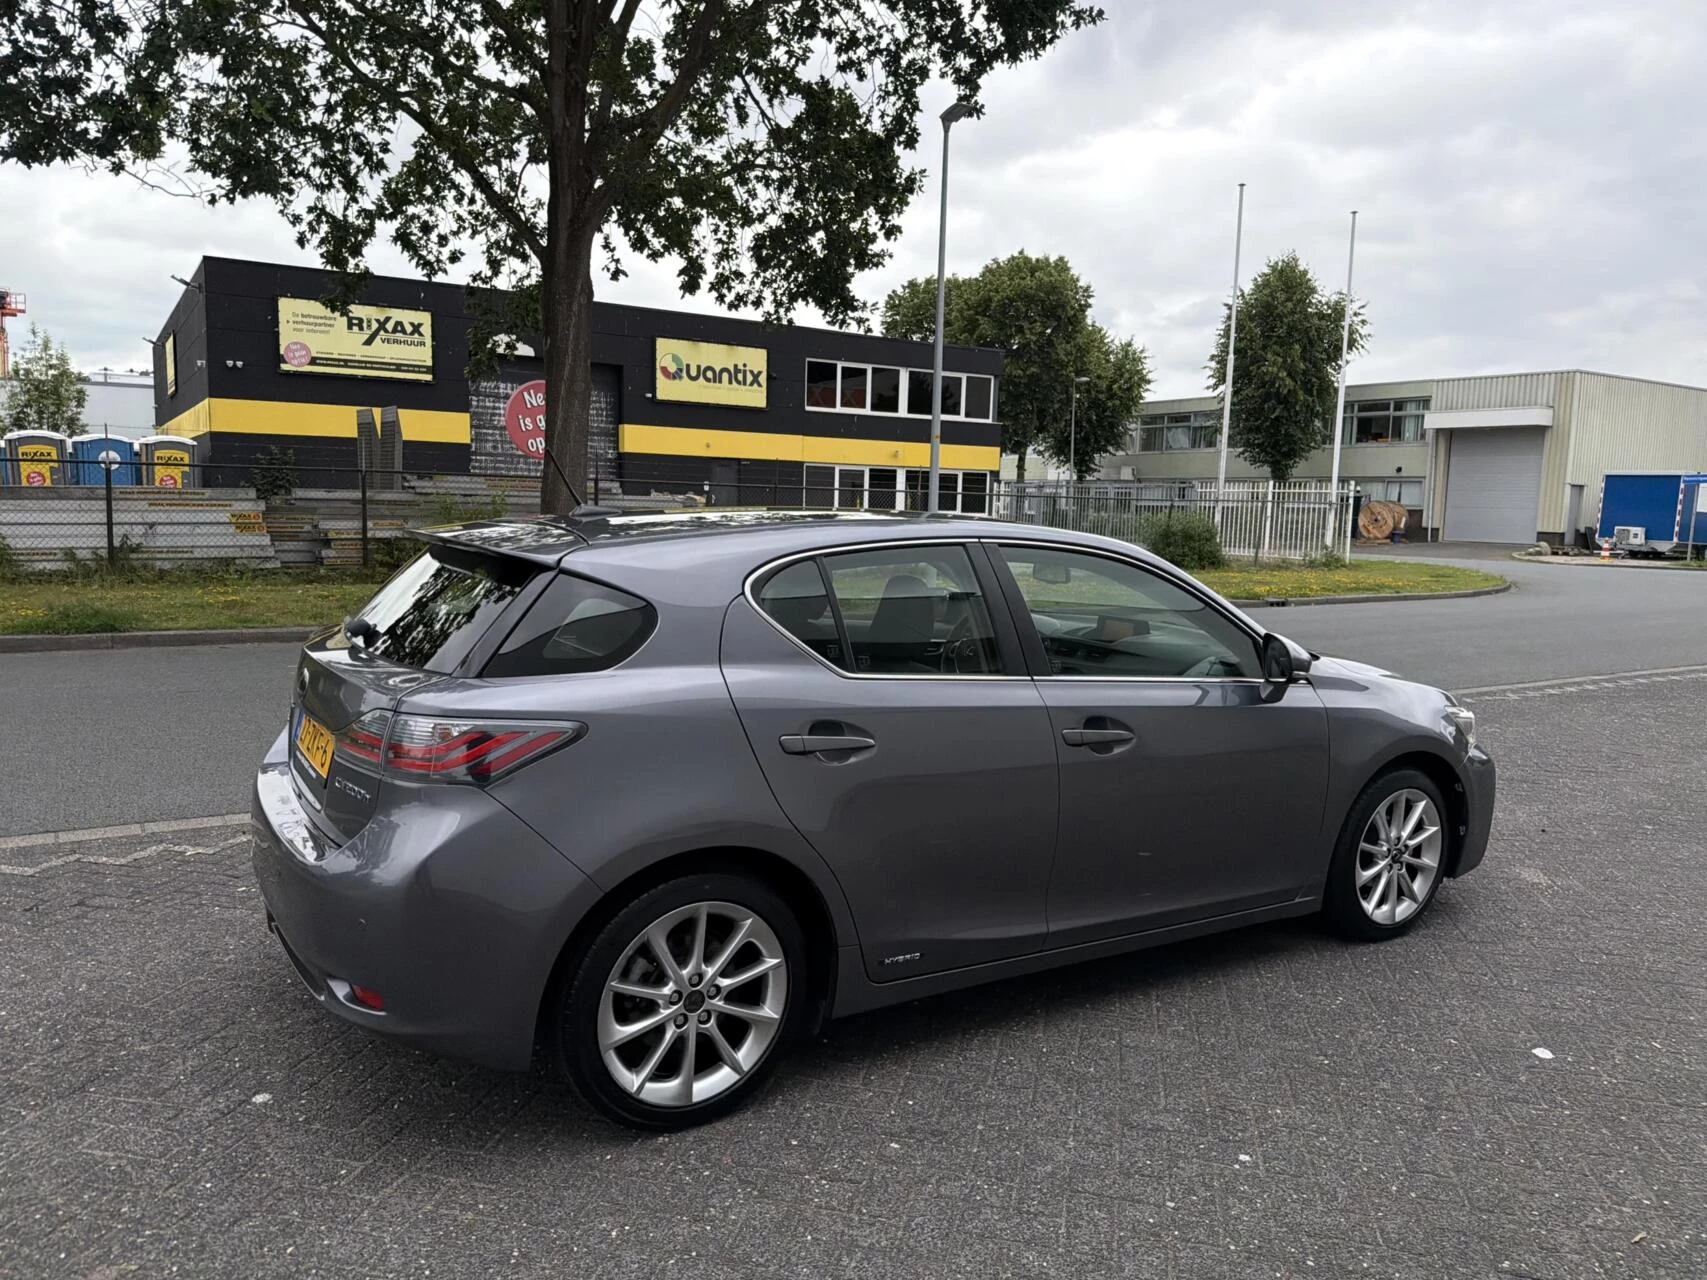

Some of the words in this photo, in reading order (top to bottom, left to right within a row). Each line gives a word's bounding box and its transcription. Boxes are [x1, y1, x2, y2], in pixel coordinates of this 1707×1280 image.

[380, 337, 426, 347] VERHUUR
[523, 389, 545, 408] Ne
[519, 414, 533, 431] is
[884, 952, 920, 965] HYBRID
